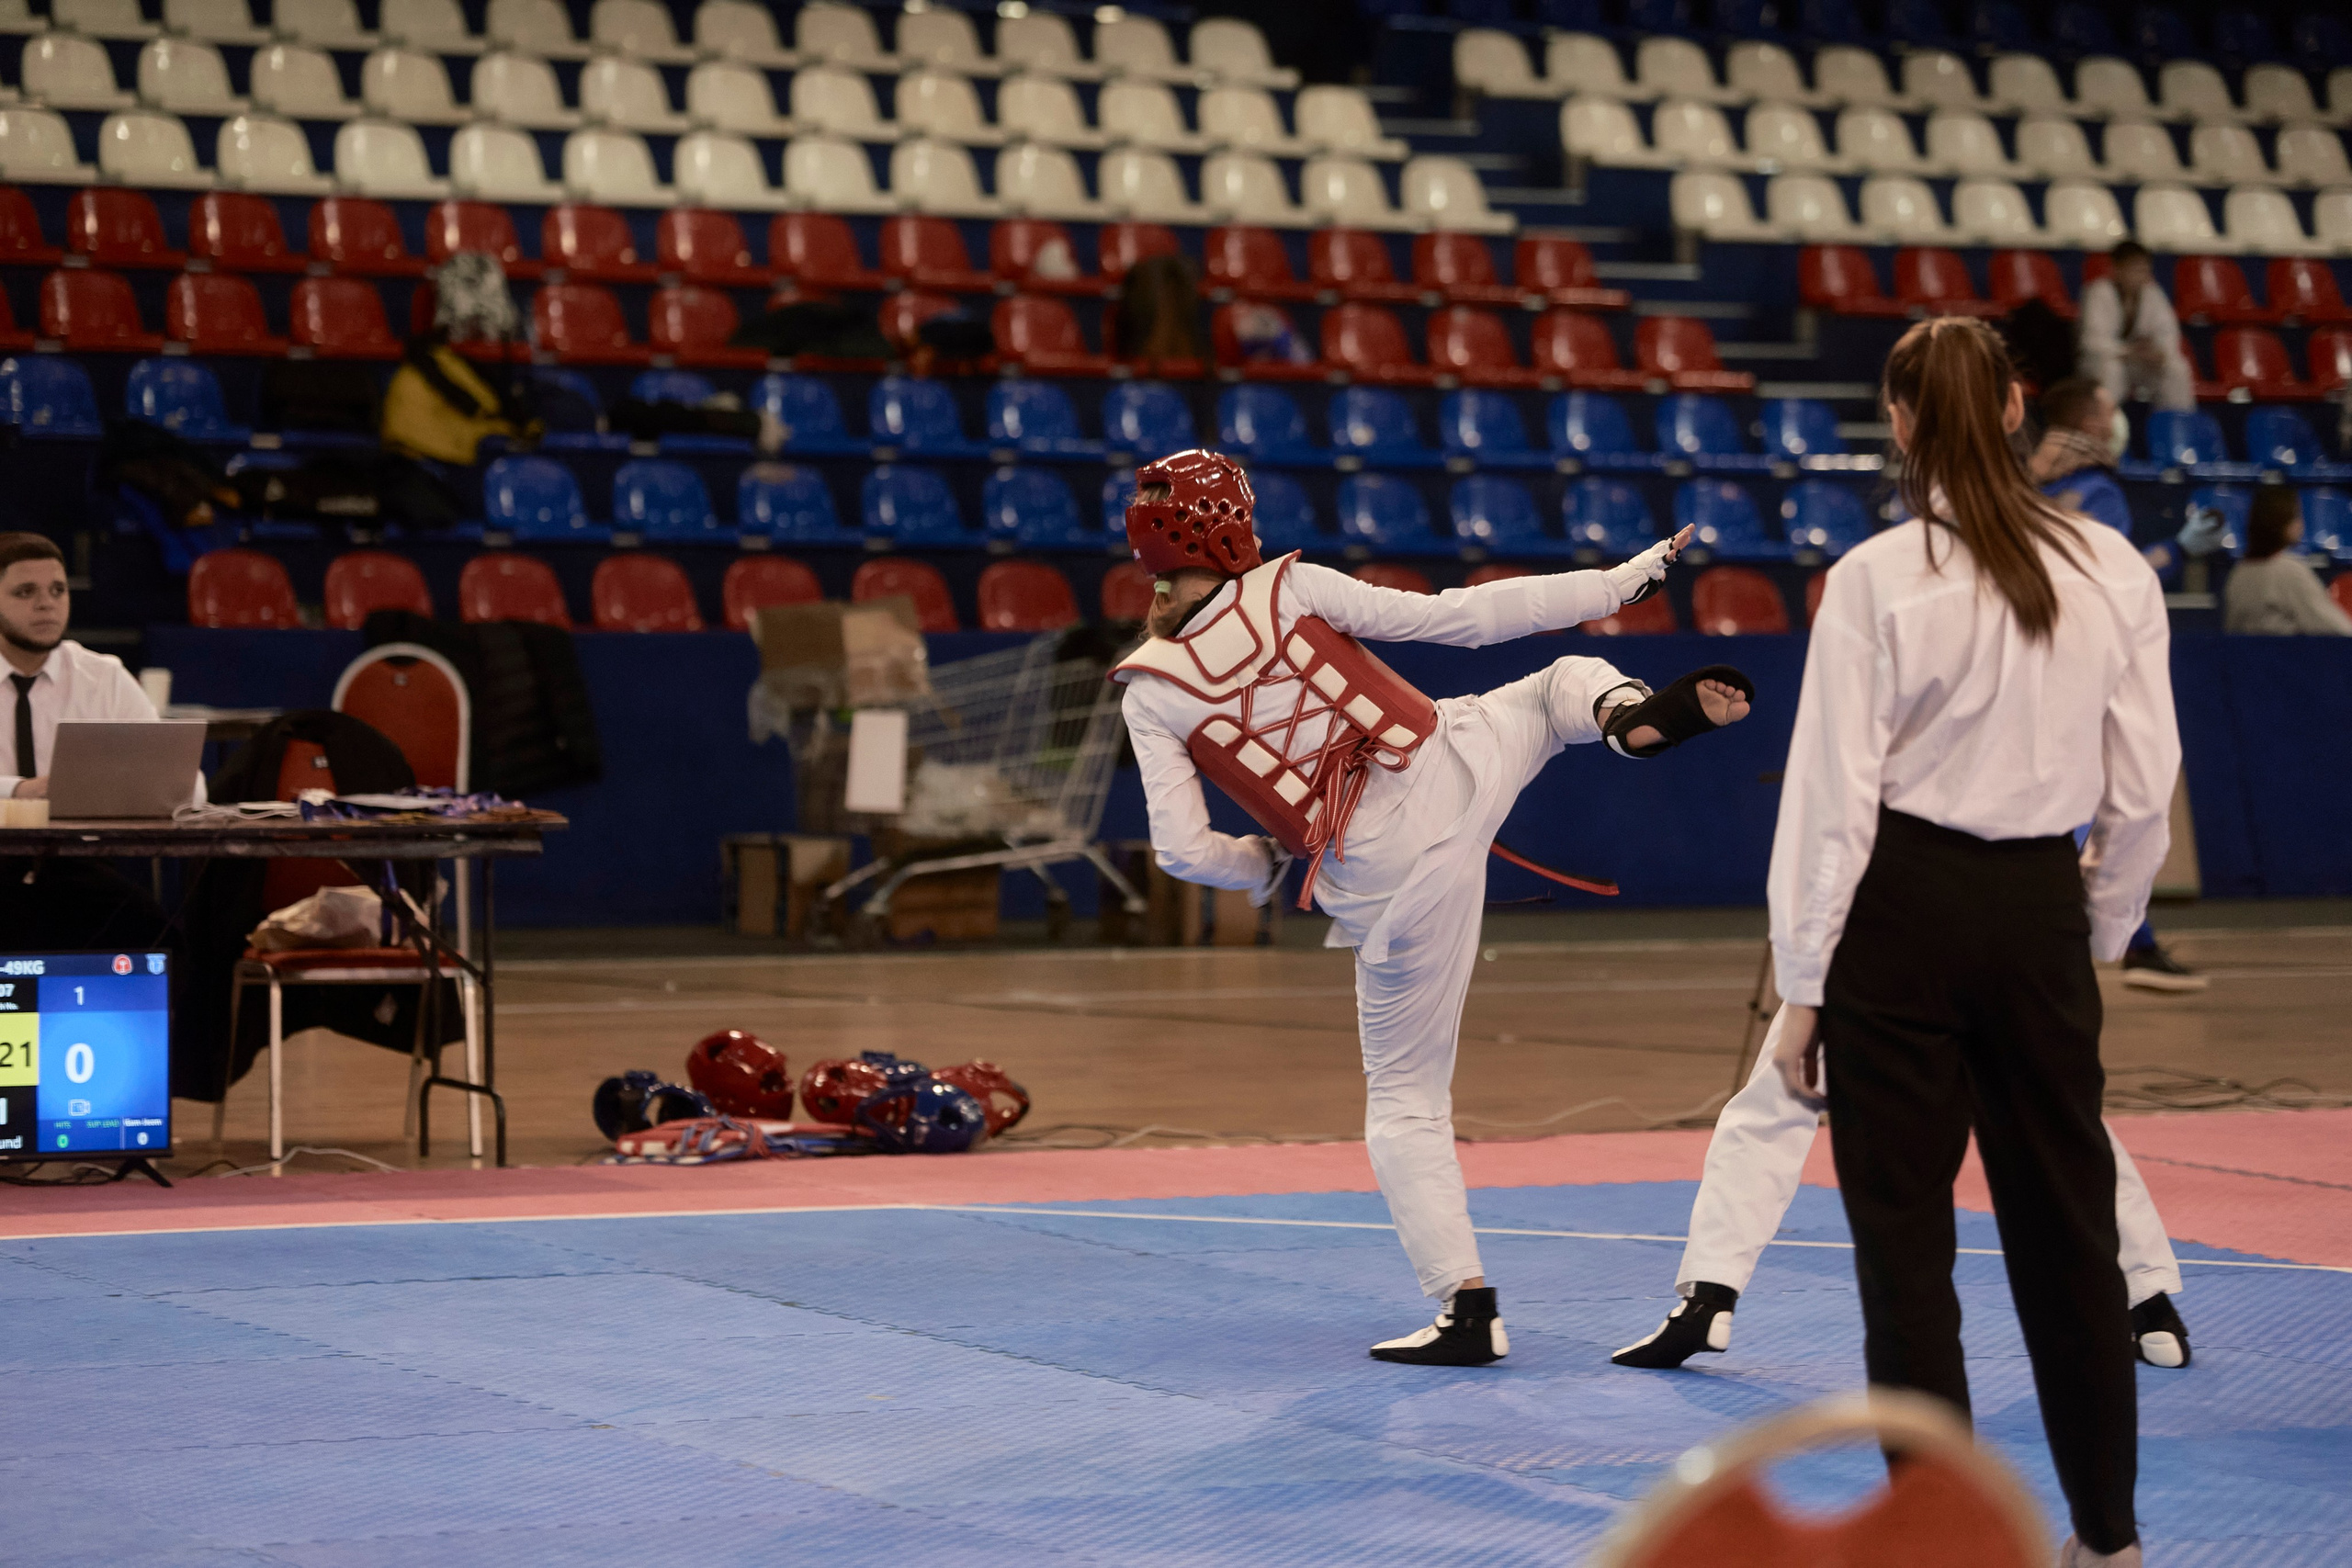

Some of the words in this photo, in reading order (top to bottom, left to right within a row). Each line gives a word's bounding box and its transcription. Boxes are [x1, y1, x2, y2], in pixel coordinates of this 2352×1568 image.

[74, 986, 85, 1006] 1
[0, 1042, 31, 1067] 21
[65, 1043, 95, 1084] 0
[57, 1134, 69, 1148] 0
[137, 1132, 149, 1145] 0
